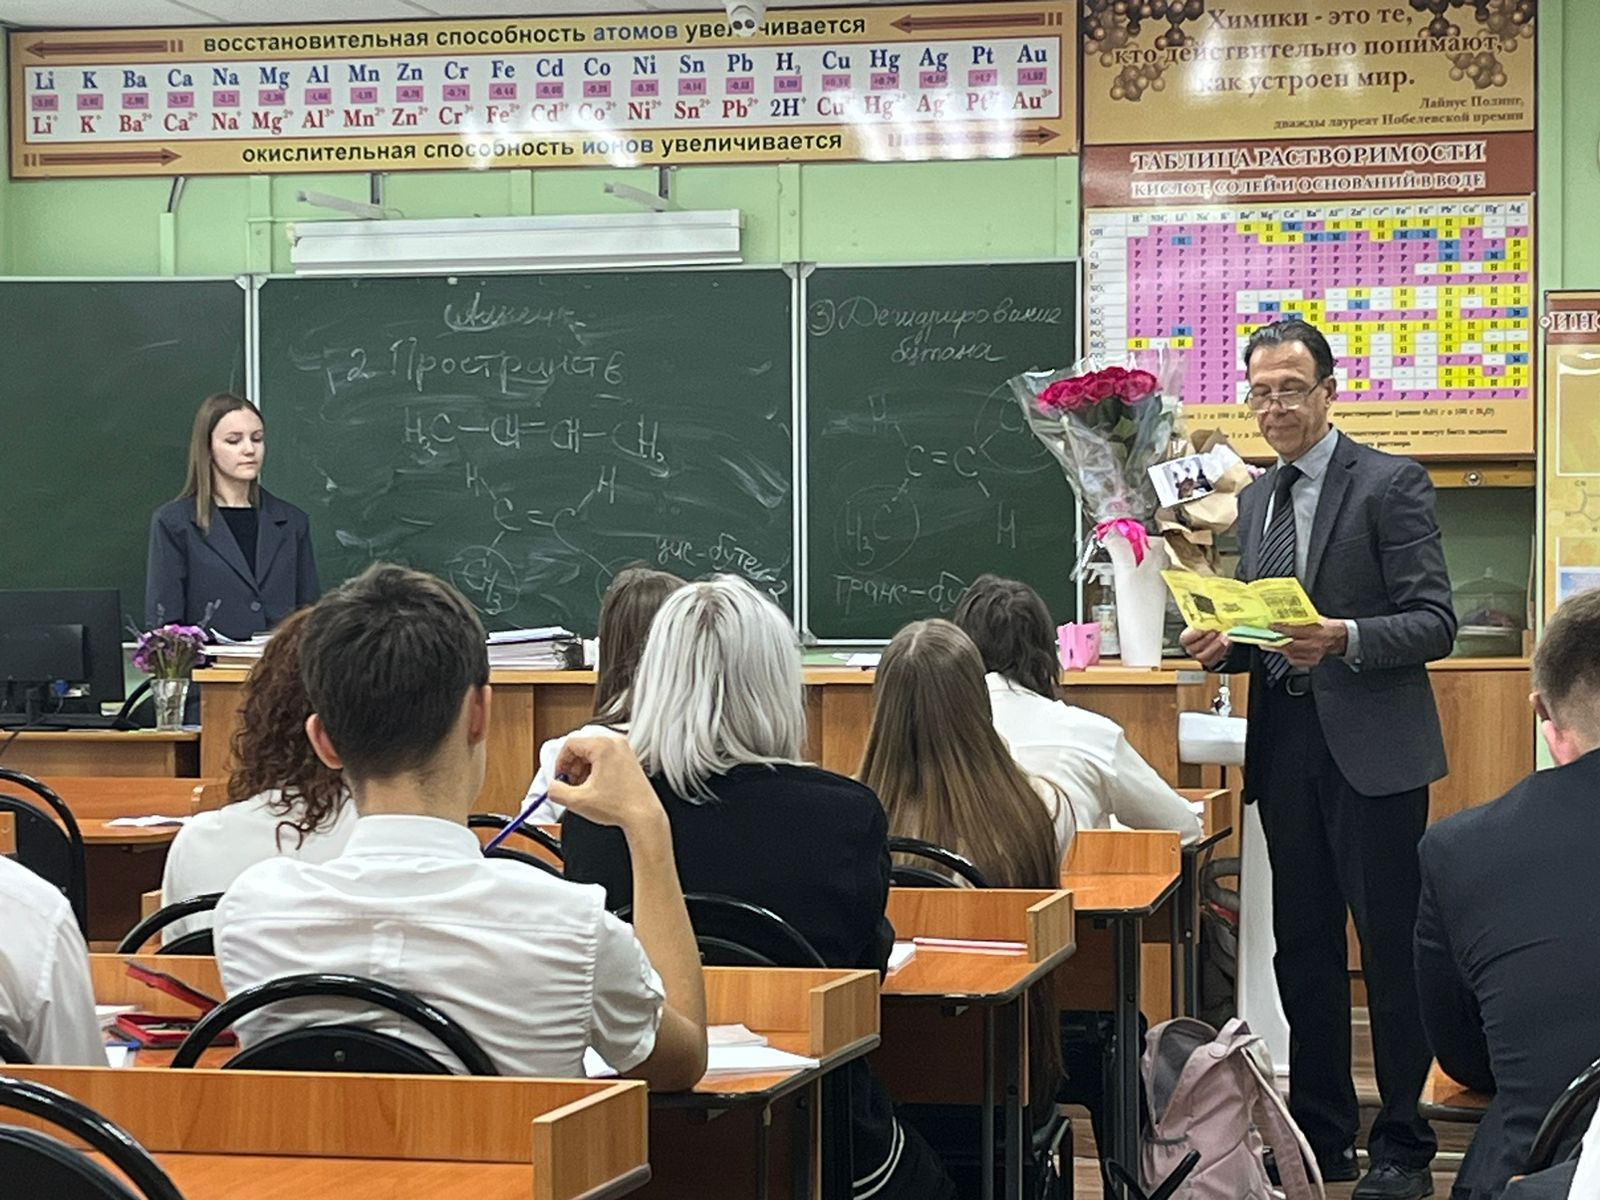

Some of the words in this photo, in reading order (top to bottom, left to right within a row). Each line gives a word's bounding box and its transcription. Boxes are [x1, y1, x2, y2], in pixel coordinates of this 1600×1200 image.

[1207, 9, 1308, 30] Химики
[1328, 10, 1370, 25] это
[1377, 9, 1413, 25] те,
[203, 32, 428, 52] восстановительная
[436, 25, 585, 46] способность
[593, 24, 678, 42] атомов
[685, 18, 866, 43] увечивается
[1115, 49, 1157, 64] кто
[1165, 41, 1357, 65] действительно
[1364, 36, 1502, 56] понимают,
[35, 71, 55, 90] Li
[82, 71, 98, 89] K
[122, 70, 147, 88] Ba
[168, 69, 193, 87] Ca
[213, 67, 240, 86] Na
[259, 67, 290, 90] Mg
[307, 65, 329, 83] Al
[348, 63, 380, 82] Mn
[397, 63, 423, 81] Zn
[444, 61, 469, 80] Cr
[491, 60, 515, 78] Fe
[536, 58, 564, 77] Cd
[584, 57, 611, 76] Co
[633, 55, 657, 75] Ni
[679, 54, 705, 74] Sn
[727, 53, 753, 72] Pb
[822, 51, 851, 69] Cu
[869, 49, 901, 73] Hg
[919, 48, 948, 71] Ag
[972, 46, 995, 65] Pt
[1016, 44, 1047, 63] Au
[1200, 75, 1240, 92] как
[1248, 72, 1348, 98] устроен
[1358, 70, 1415, 93] мир.
[1419, 97, 1467, 109] Лайнус
[1273, 118, 1325, 130] дважды
[1328, 116, 1378, 129] лауреат
[1382, 113, 1470, 126] Нобелевской
[1473, 110, 1523, 125] премии
[242, 146, 416, 164] окислительная
[423, 138, 575, 159] способность
[582, 137, 654, 155] ионов
[661, 133, 842, 157] увеличивается
[1133, 150, 1250, 172] ТАБЛИЦА
[1257, 143, 1483, 166] РАСТВОРИМОСТИ
[1214, 176, 1276, 193] СОЛЕЙ
[1281, 179, 1294, 192] И
[1299, 172, 1416, 192] ОСНОВАНИЙ
[1421, 175, 1432, 188] В
[1436, 173, 1485, 190] ВОДЕ
[890, 334, 1008, 366] бутана
